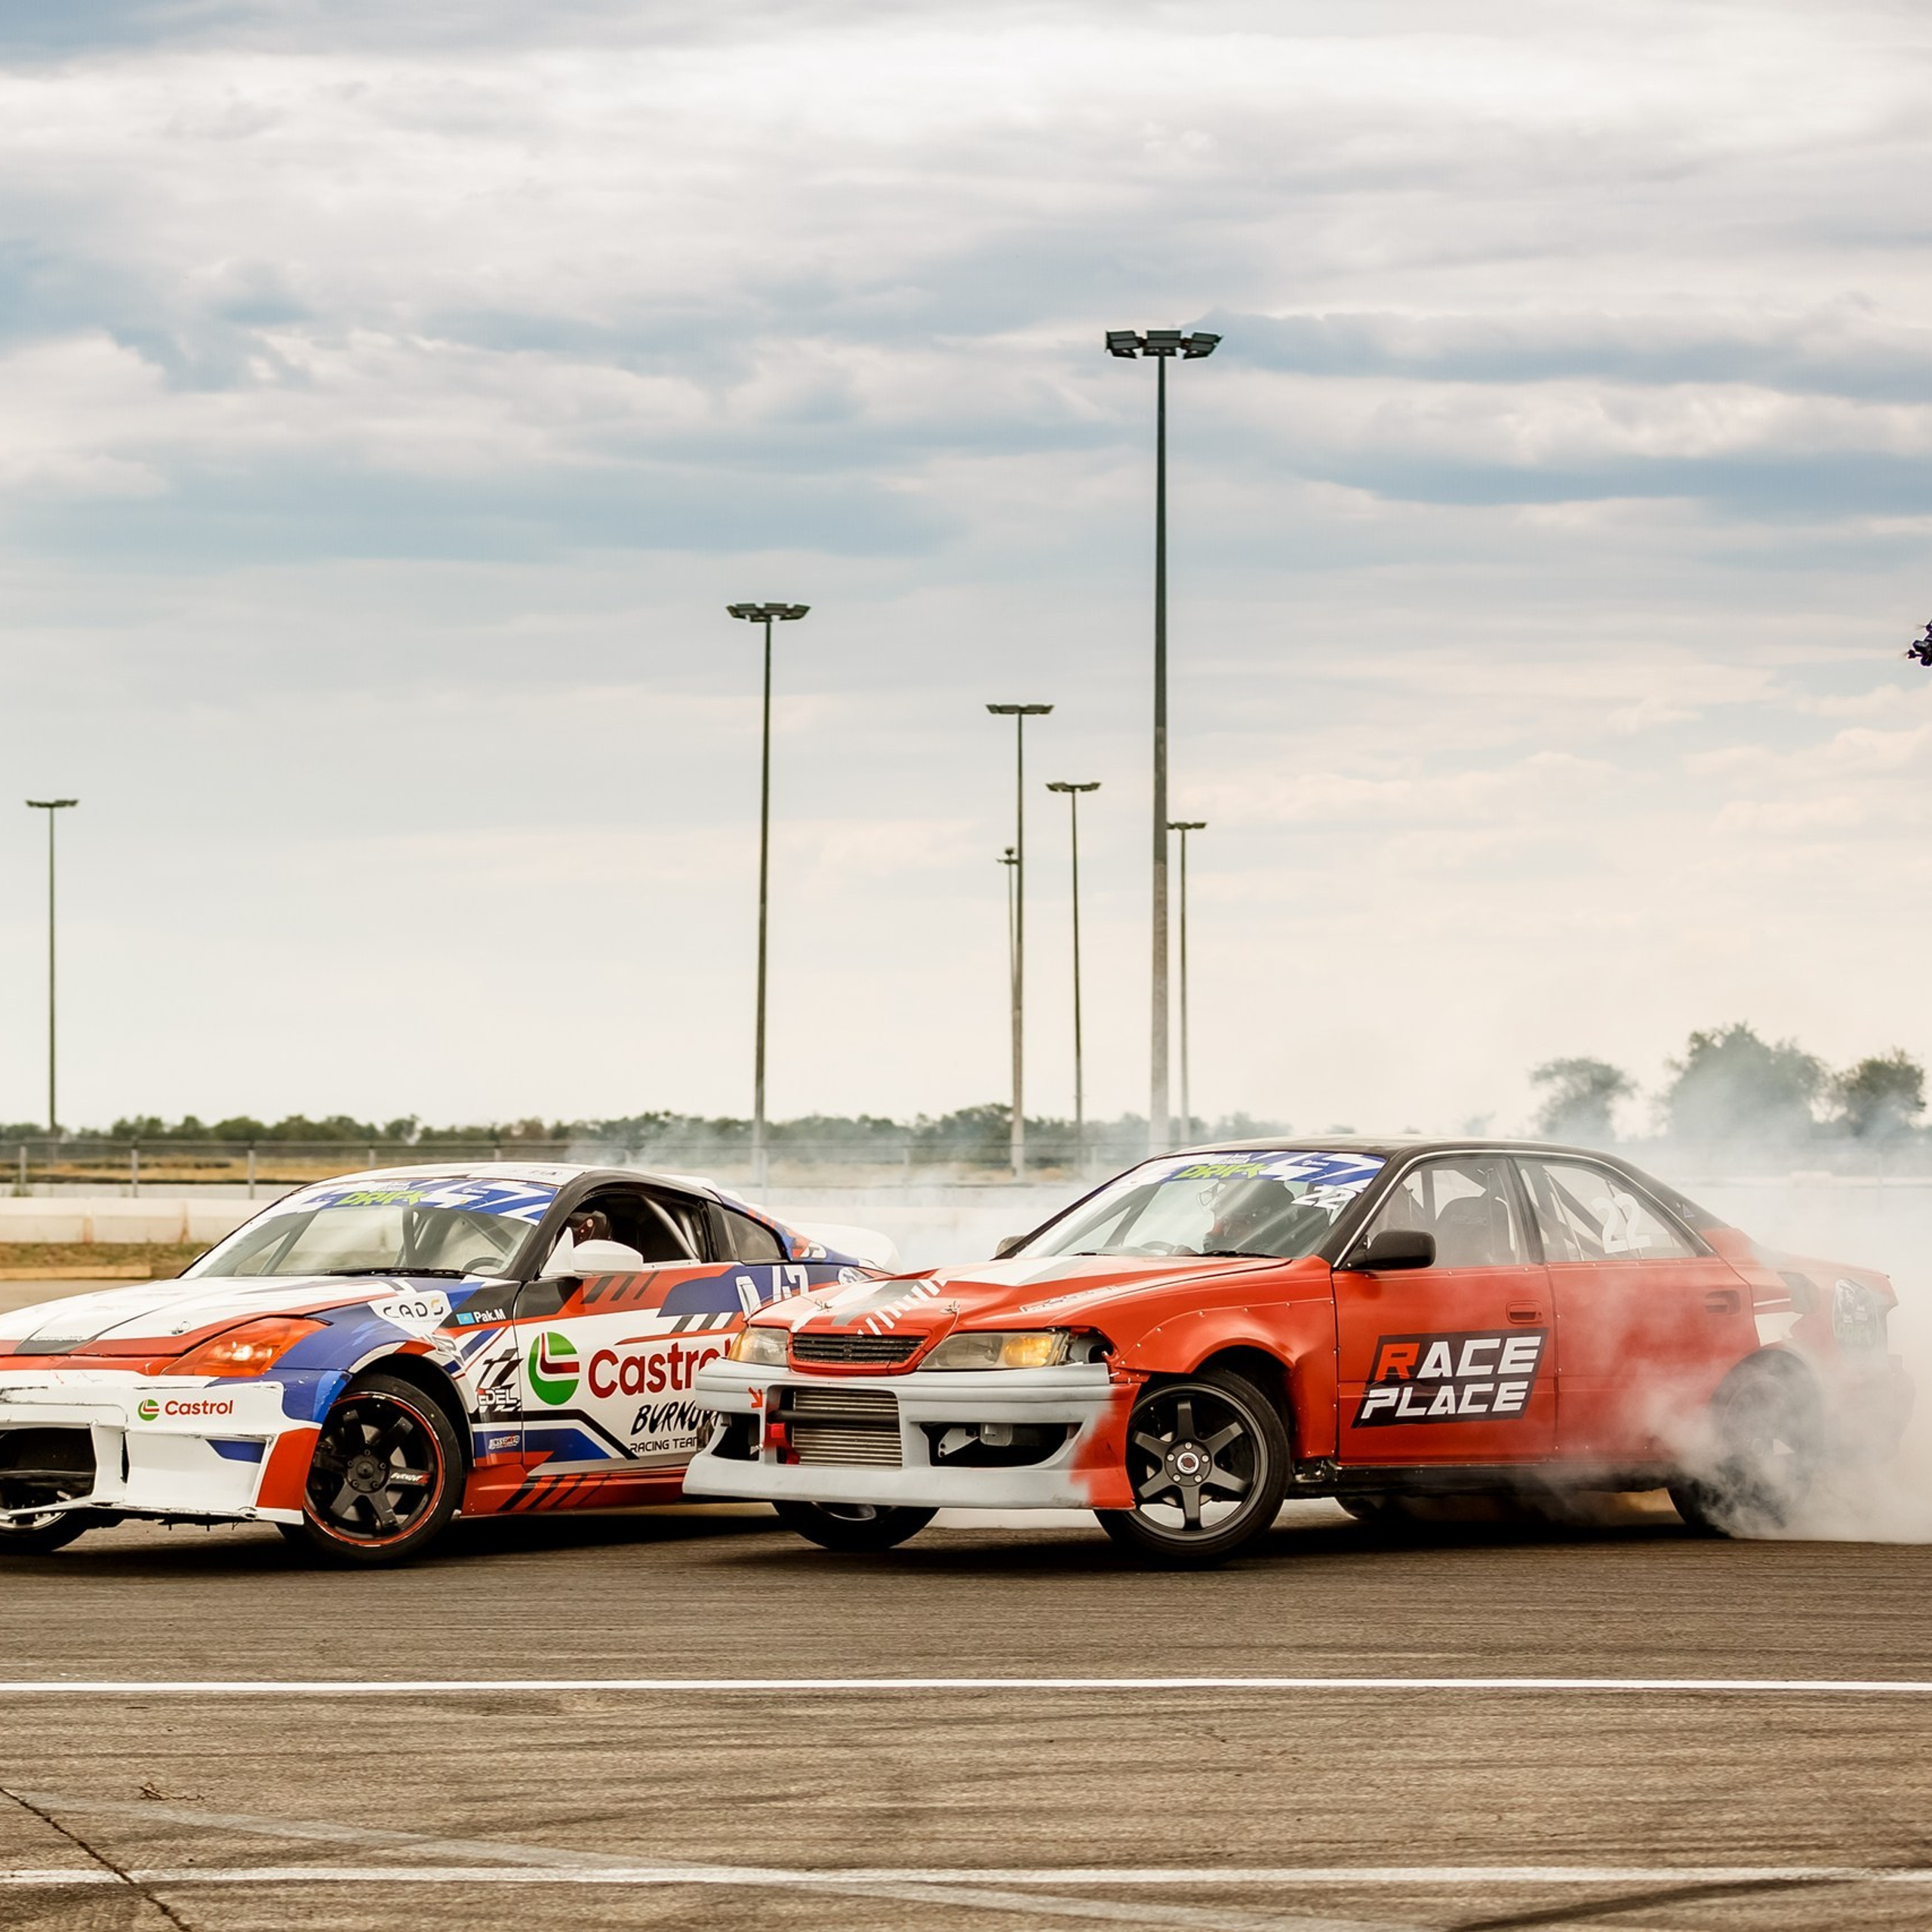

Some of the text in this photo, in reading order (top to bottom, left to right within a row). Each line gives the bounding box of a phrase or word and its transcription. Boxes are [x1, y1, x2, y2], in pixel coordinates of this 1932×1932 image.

[1591, 1192, 1652, 1254] 22
[1375, 1337, 1542, 1380] RACE
[165, 1399, 233, 1416] Castrol
[1361, 1381, 1528, 1420] PLACE
[630, 1439, 669, 1453] RACING
